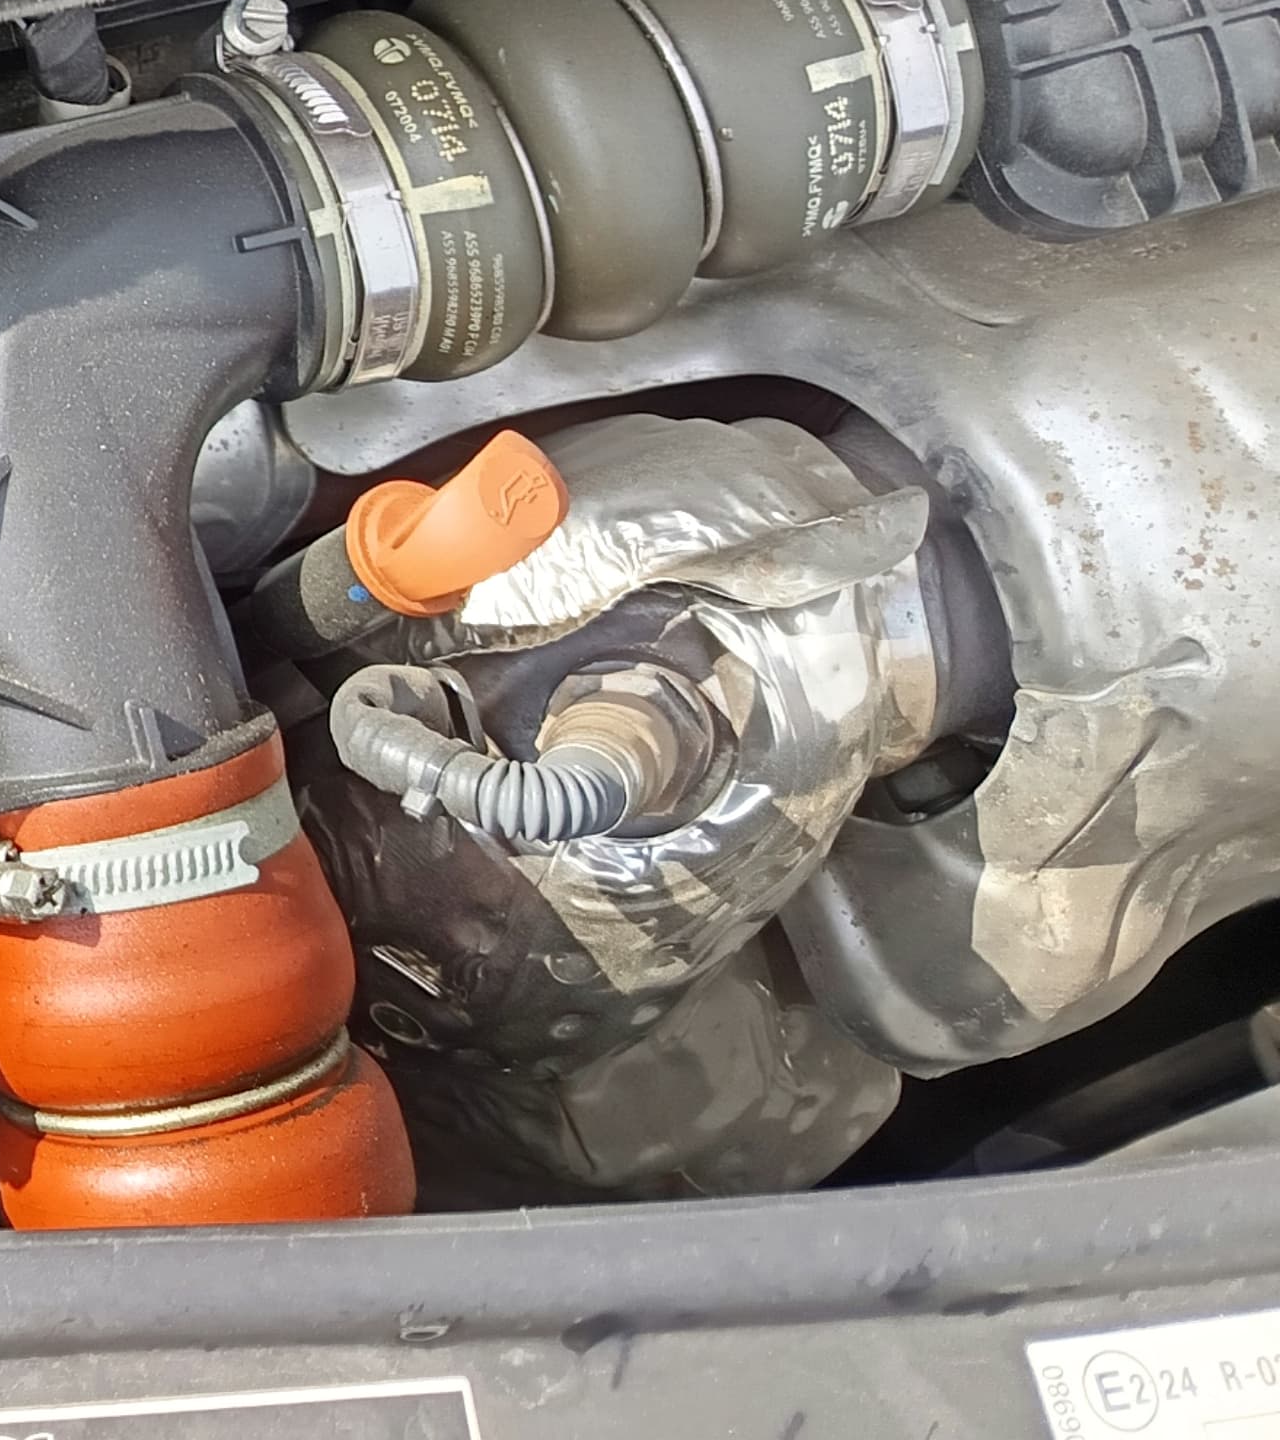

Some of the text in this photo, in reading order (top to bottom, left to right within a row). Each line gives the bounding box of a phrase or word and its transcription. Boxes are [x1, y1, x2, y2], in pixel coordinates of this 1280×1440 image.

[384, 90, 422, 143] 072004
[411, 80, 468, 162] 0714
[440, 230, 456, 255] ASS
[463, 230, 479, 257] ASS
[1159, 1366, 1198, 1401] 24
[1218, 1354, 1280, 1392] R-0
